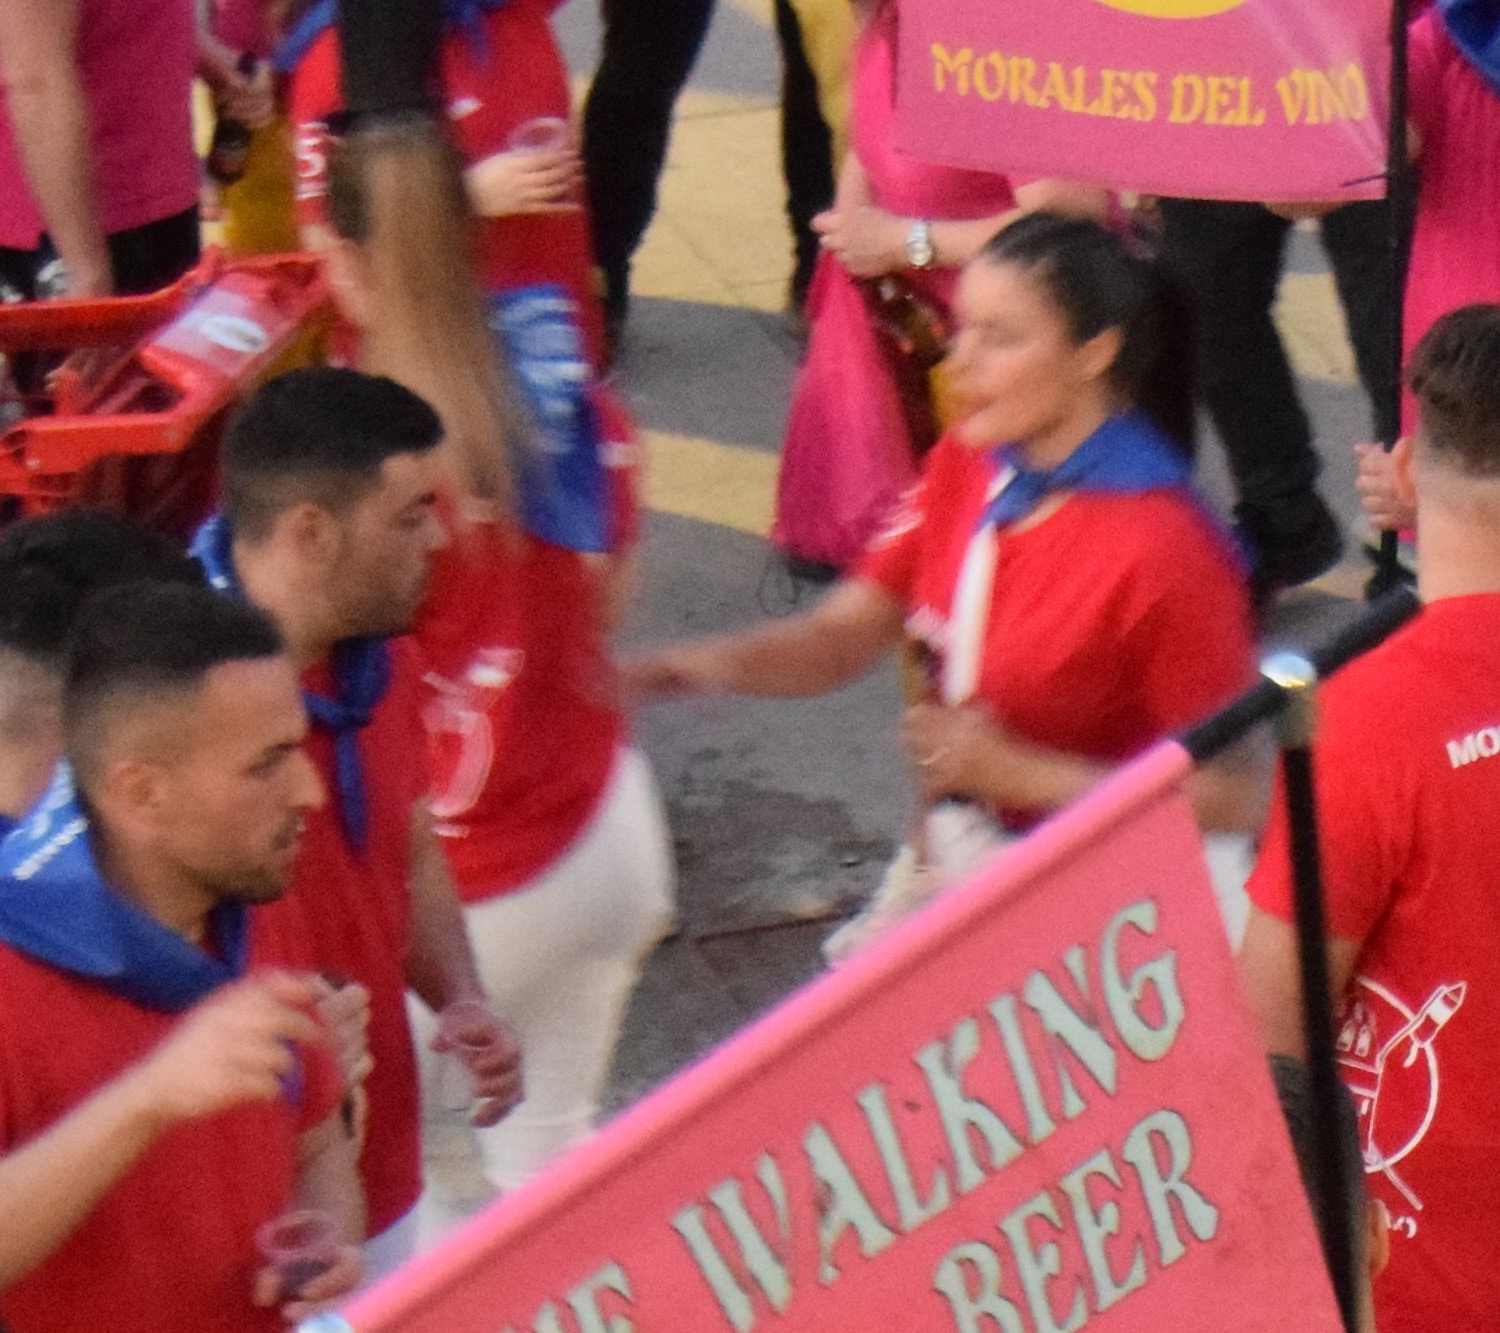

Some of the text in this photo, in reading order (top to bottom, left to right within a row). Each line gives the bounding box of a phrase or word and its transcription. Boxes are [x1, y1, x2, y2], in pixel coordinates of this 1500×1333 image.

[930, 42, 1370, 127] MORALES DEL VINO
